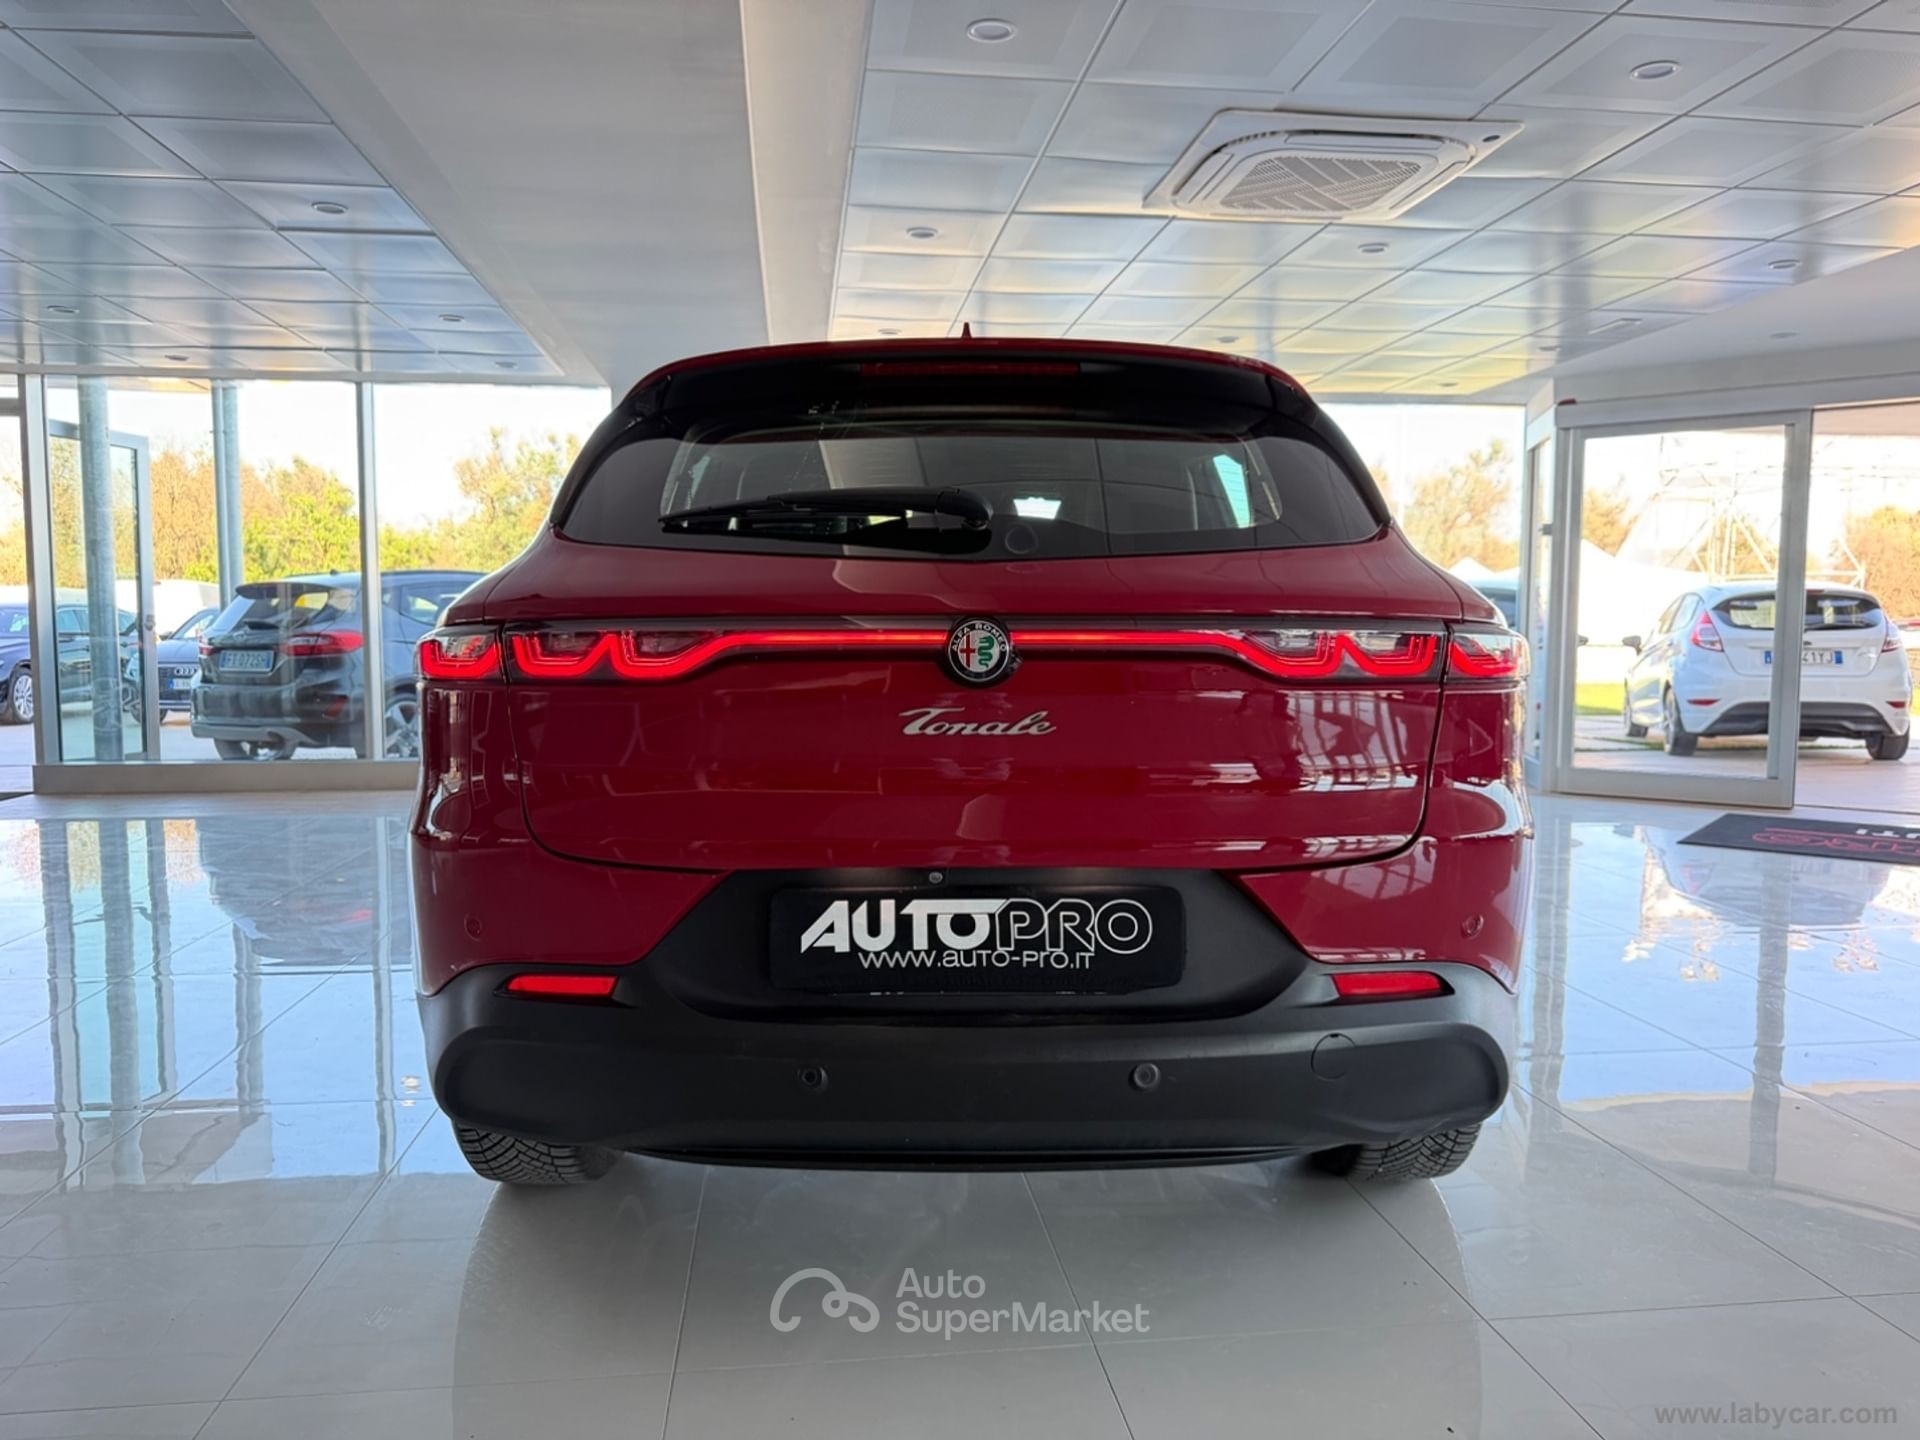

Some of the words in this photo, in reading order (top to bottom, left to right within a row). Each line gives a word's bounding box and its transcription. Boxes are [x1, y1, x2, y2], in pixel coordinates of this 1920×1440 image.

[952, 626, 971, 652] ALFA
[975, 623, 1006, 651] ROMEO
[899, 707, 1056, 735] Tonale
